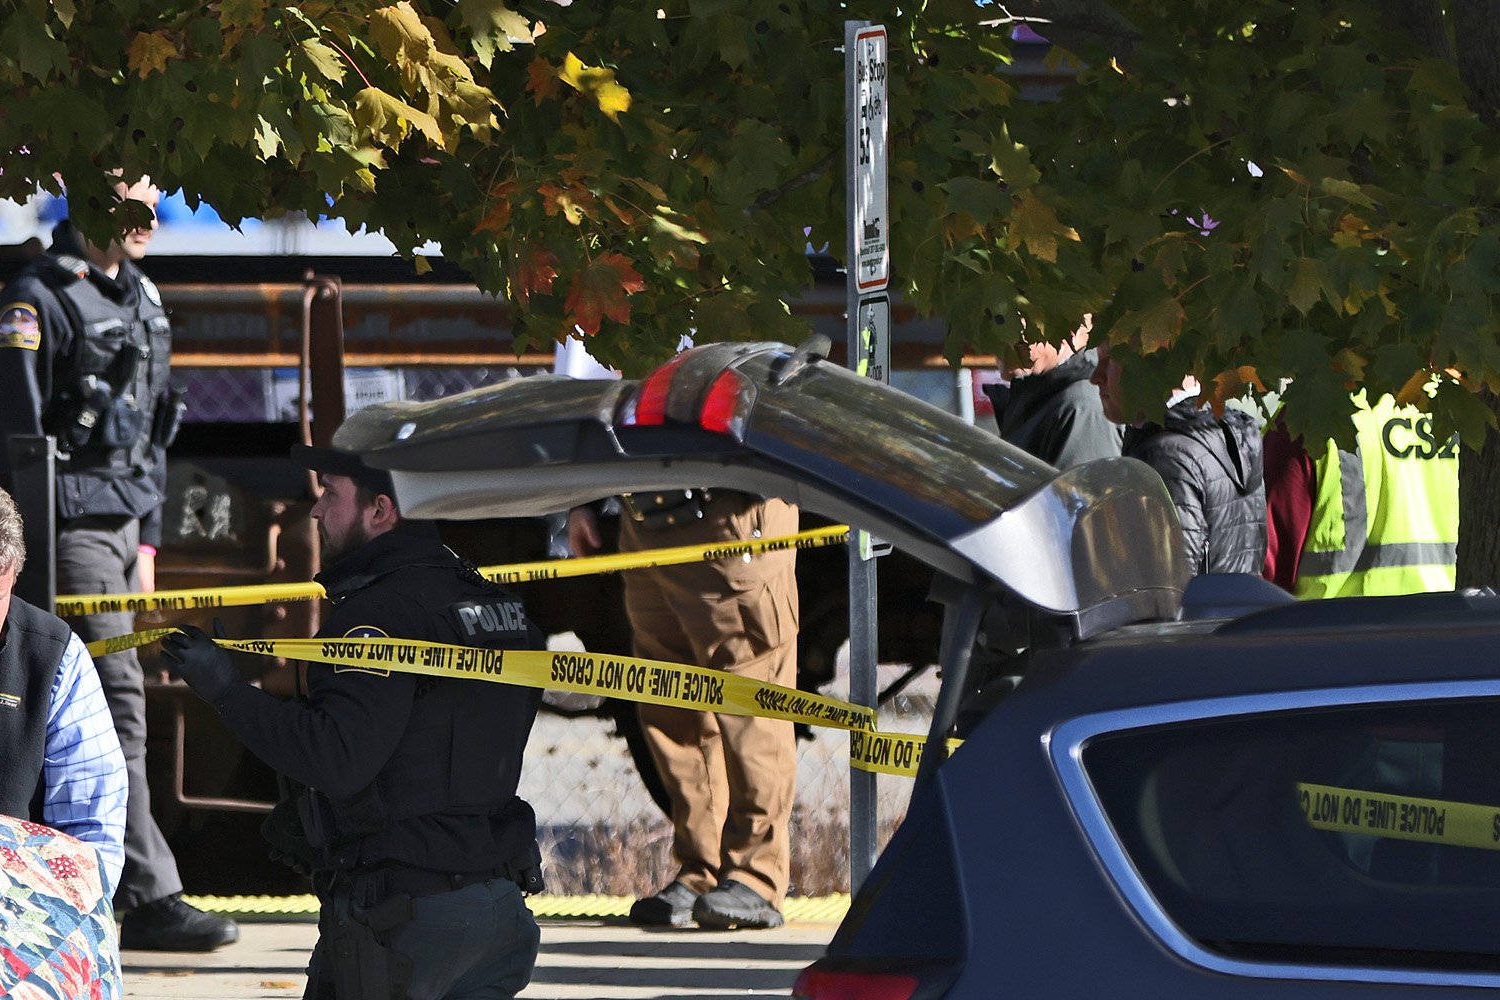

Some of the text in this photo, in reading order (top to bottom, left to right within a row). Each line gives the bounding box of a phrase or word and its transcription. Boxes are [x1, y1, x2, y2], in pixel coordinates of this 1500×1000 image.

[870, 58, 885, 86] Stop
[860, 126, 870, 165] 53
[458, 601, 528, 636] POLICE
[456, 648, 504, 676] POLICE
[551, 653, 725, 706] POLICE LINE: DO NOT CROSS
[863, 734, 893, 766] NOT
[893, 740, 914, 769] DO
[1312, 792, 1340, 824] NOT
[1342, 795, 1362, 826] DO
[1364, 798, 1398, 831] LINE:
[1399, 803, 1446, 837] POLICE
